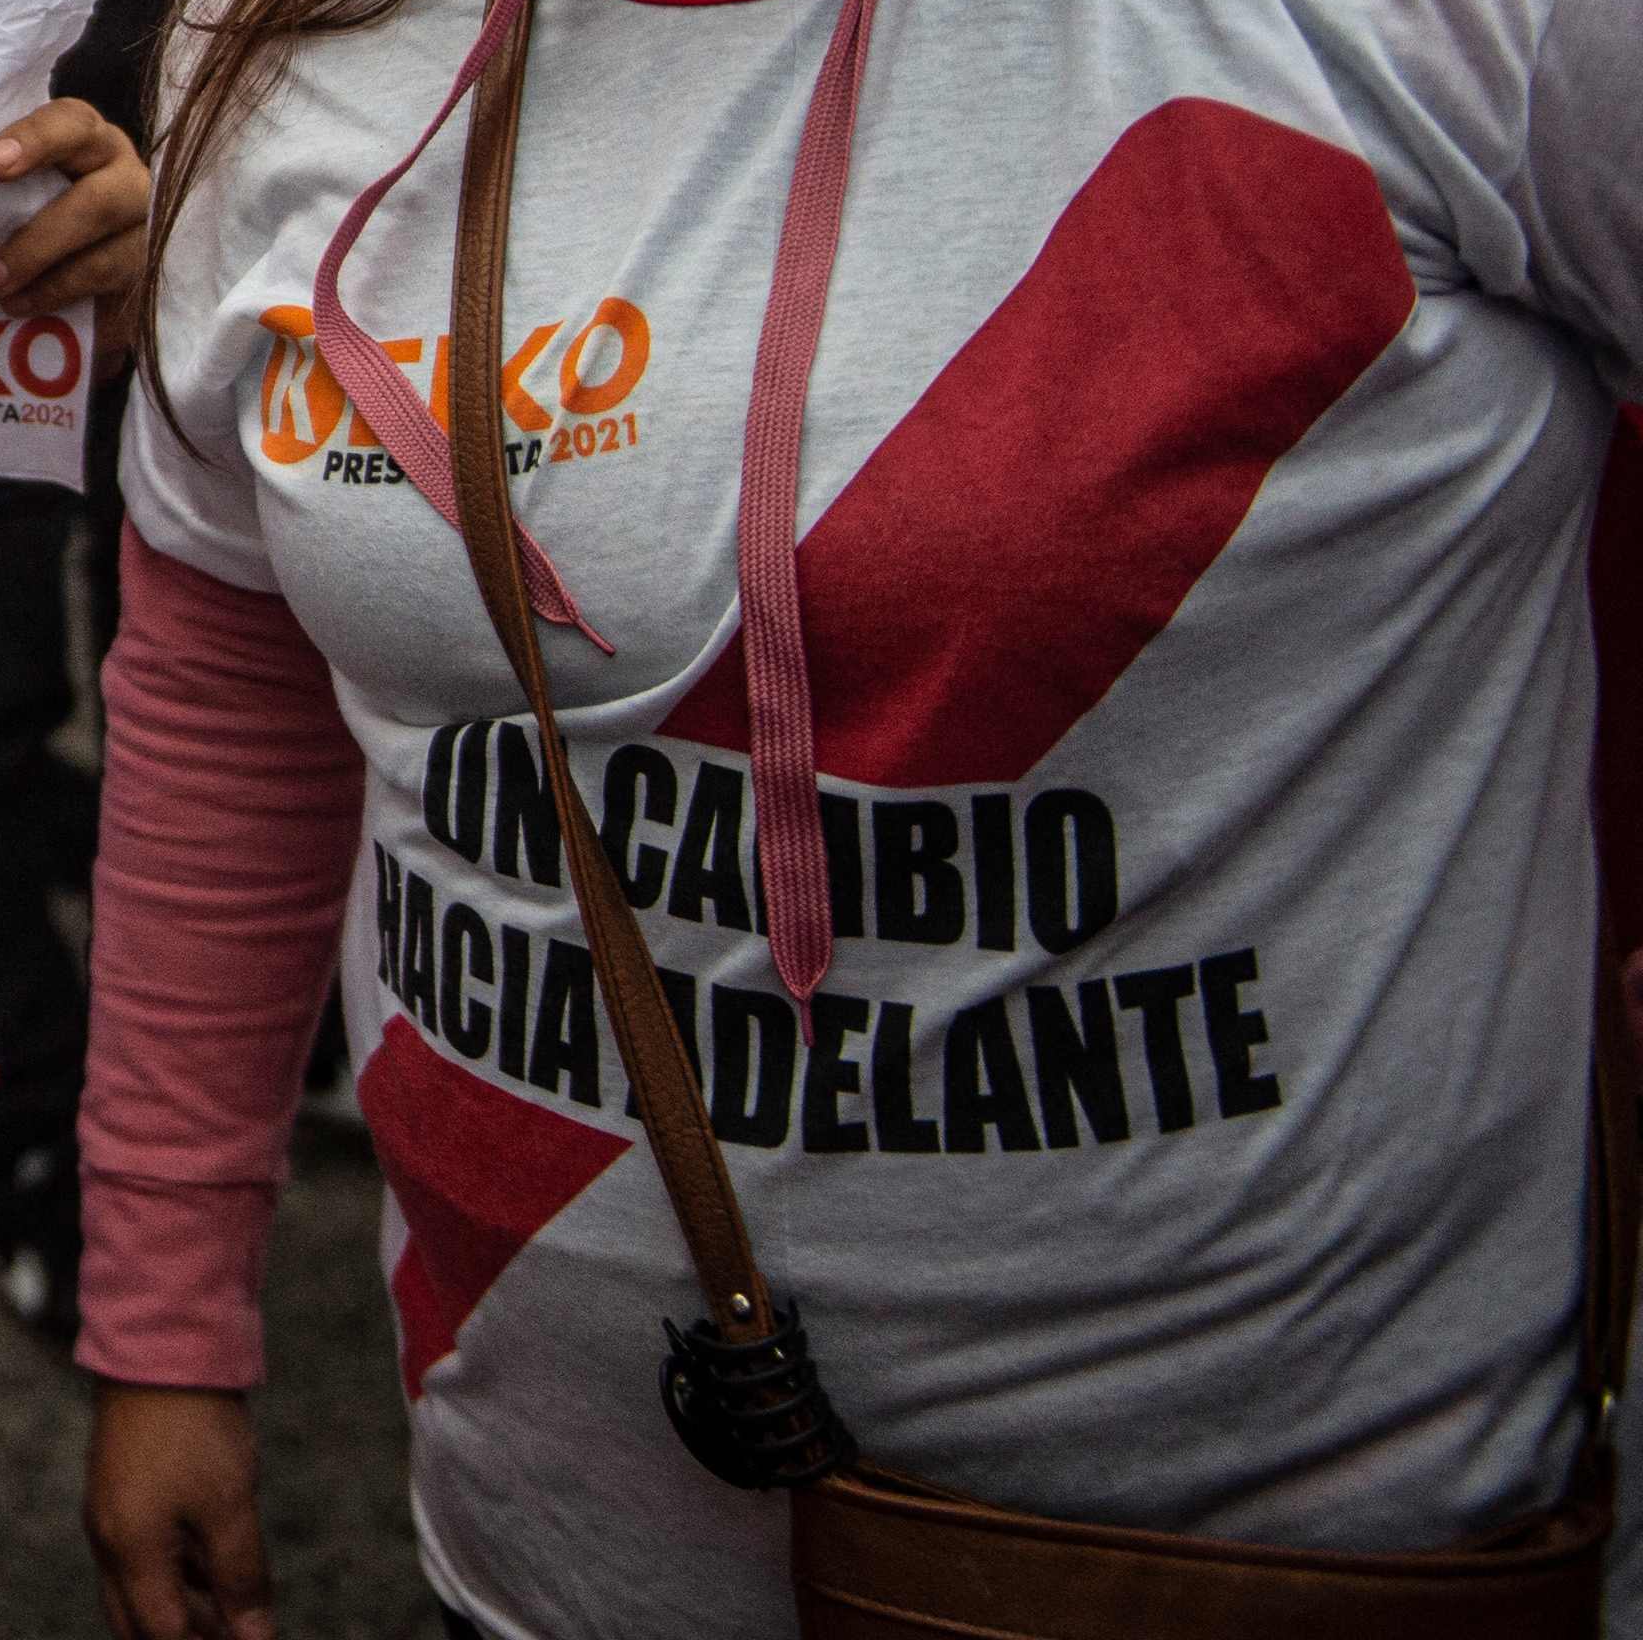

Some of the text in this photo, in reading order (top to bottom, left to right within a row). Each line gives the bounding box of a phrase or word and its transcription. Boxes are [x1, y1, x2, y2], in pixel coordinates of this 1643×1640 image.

[549, 412, 638, 464] 2021
[423, 718, 568, 888] UN
[374, 838, 602, 1108] HACIA
